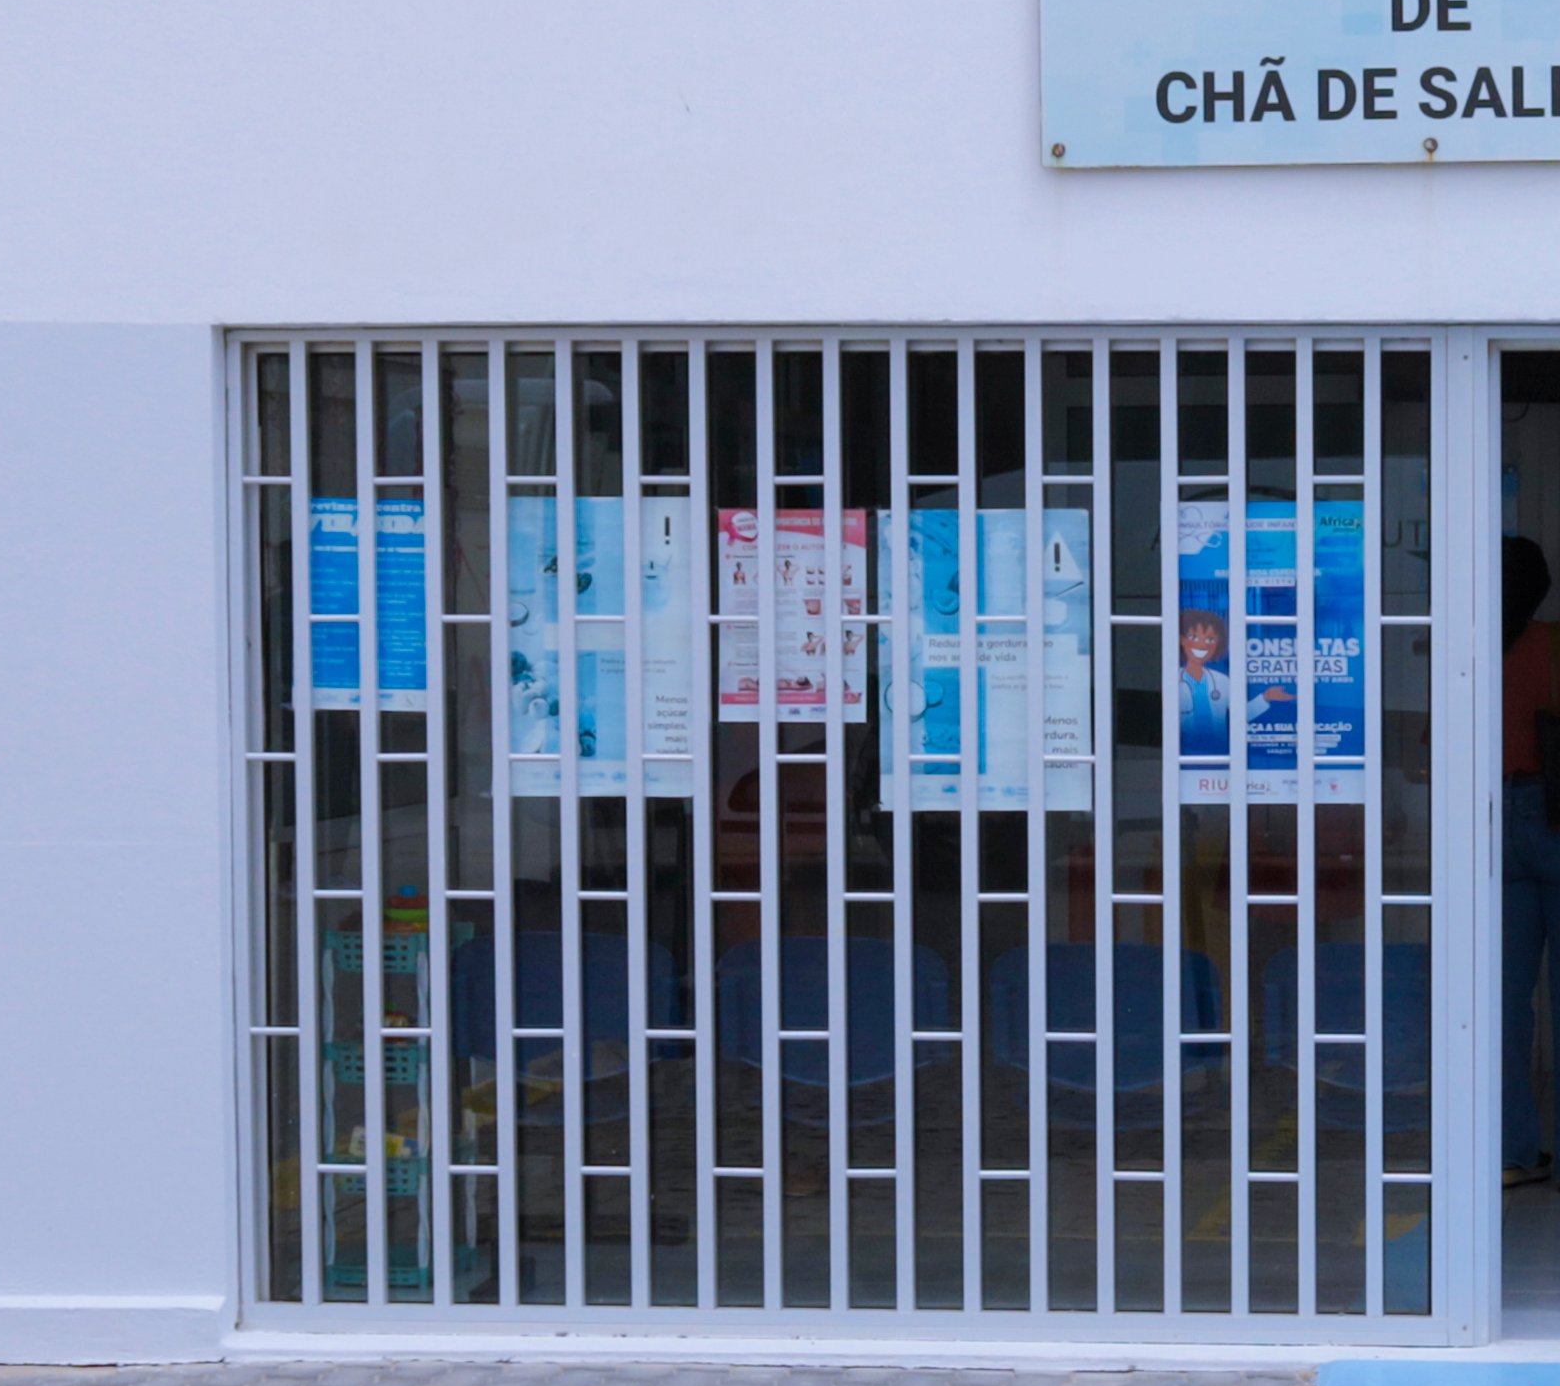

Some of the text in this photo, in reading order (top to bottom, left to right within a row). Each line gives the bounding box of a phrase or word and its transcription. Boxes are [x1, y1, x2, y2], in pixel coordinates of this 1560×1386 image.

[1155, 57, 1297, 124] CHÃ
[1317, 68, 1398, 121] DE
[1198, 778, 1229, 791] RIU
